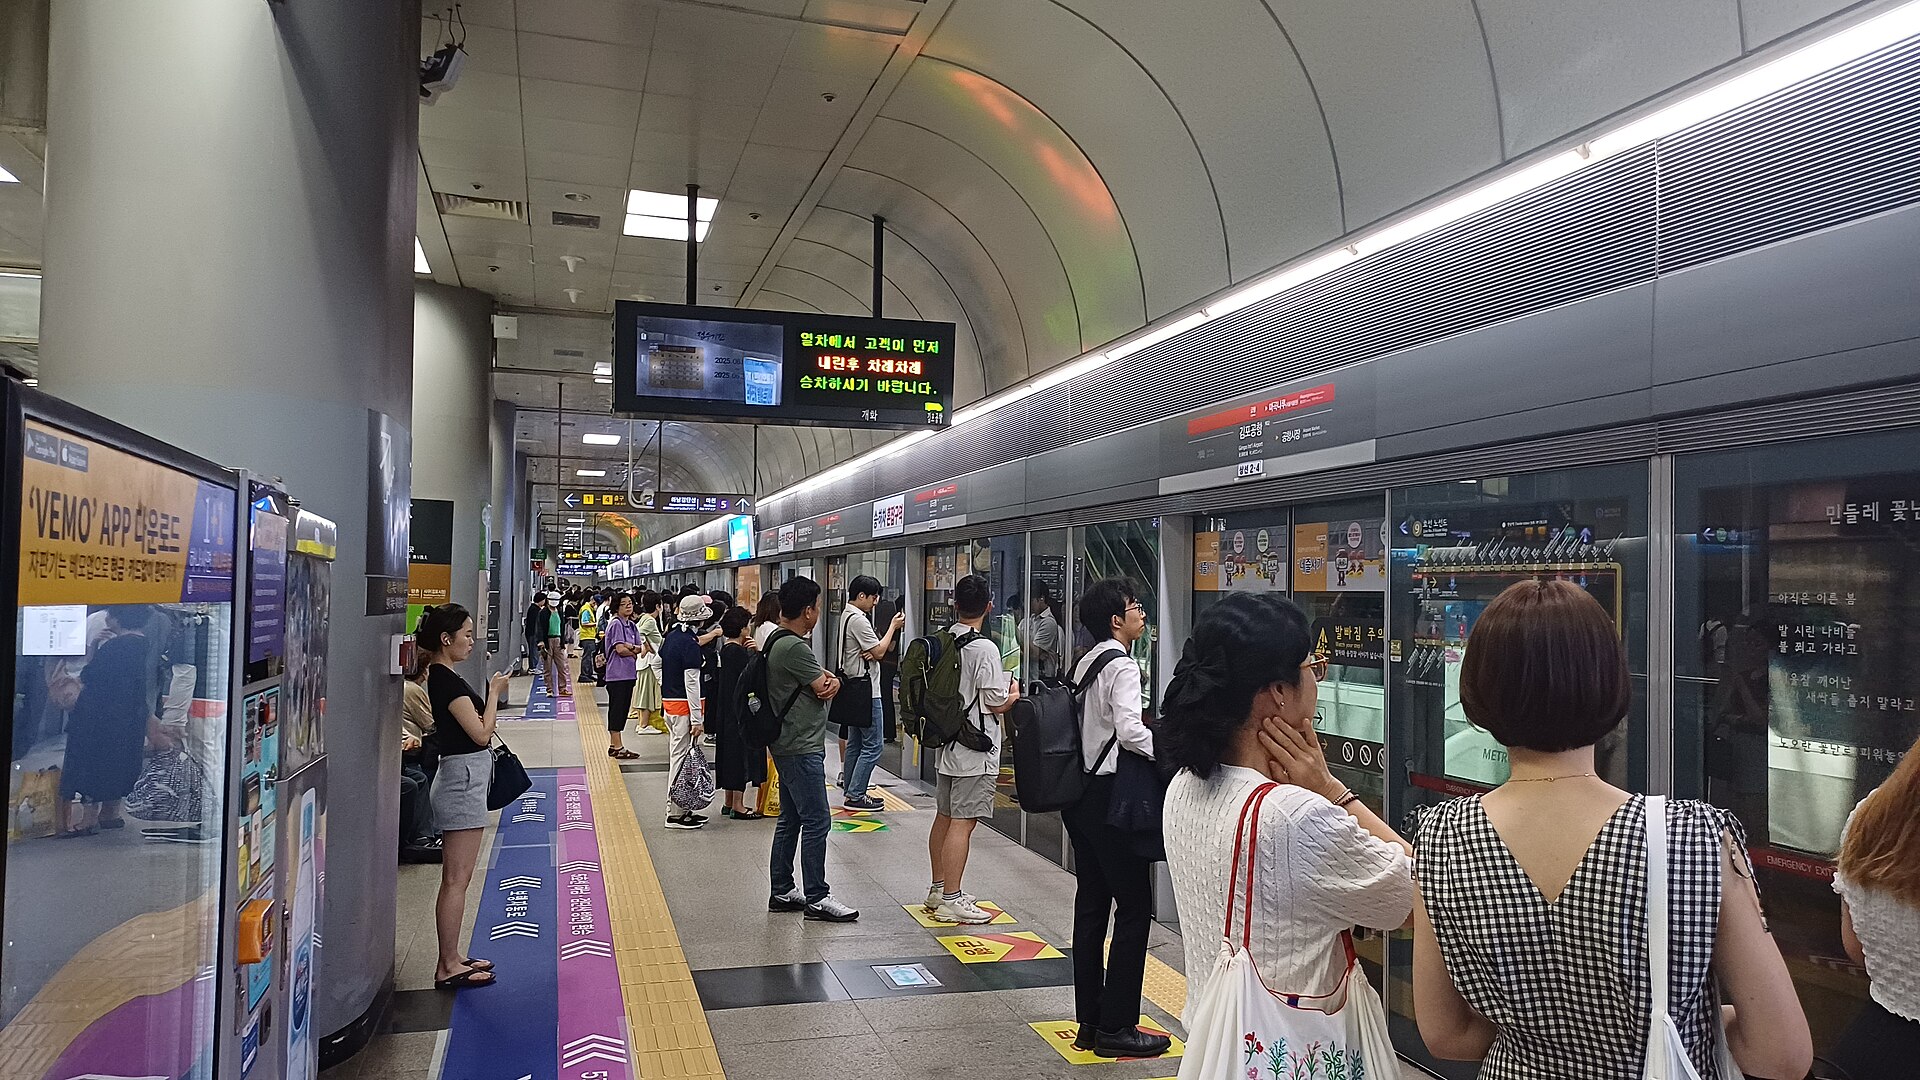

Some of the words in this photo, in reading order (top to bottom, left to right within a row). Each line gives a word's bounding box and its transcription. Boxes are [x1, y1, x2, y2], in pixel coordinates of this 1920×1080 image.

[800, 332, 856, 349] 열차에서
[865, 337, 904, 352] 고객이
[913, 339, 939, 353] 먼저
[818, 356, 859, 371] 내린후
[867, 359, 921, 374] 차례차례
[800, 375, 869, 392] 승차하시기
[877, 380, 937, 395] 바랍니다.
[861, 409, 878, 421] 개화
[1239, 422, 1263, 440] 김포공항
[1281, 428, 1301, 443] 공항시장
[720, 500, 727, 509] 5
[1826, 501, 1879, 525] 민들레
[100, 502, 131, 547] APP
[135, 499, 181, 554] 다운로드
[1423, 519, 1433, 528] 호선
[1433, 518, 1448, 528] 노선도
[29, 549, 67, 580] 자판기는
[69, 552, 109, 580] 베모앱으로
[1779, 592, 1810, 605] 아직은
[1816, 592, 1838, 605] 이른
[1845, 592, 1857, 605] 봄
[1335, 625, 1361, 641] 발빠짐
[1778, 624, 1789, 637] 발
[1795, 624, 1815, 638] 시린
[1821, 625, 1856, 640] 나비들
[1778, 641, 1789, 653] 불
[1795, 641, 1816, 654] 쬐고
[1822, 642, 1858, 656] 가라고
[1818, 675, 1852, 690] 깨어난
[1806, 691, 1840, 706] 새싹들
[1847, 693, 1870, 708] 춥지
[1877, 696, 1915, 711] 말라고
[1779, 738, 1811, 753] 노오란
[1483, 748, 1508, 763] METR
[1766, 855, 1813, 873] EMERGENCY
[1815, 866, 1834, 877] EXIT
[506, 890, 528, 918] 보행자통로
[955, 940, 995, 956] 급행
